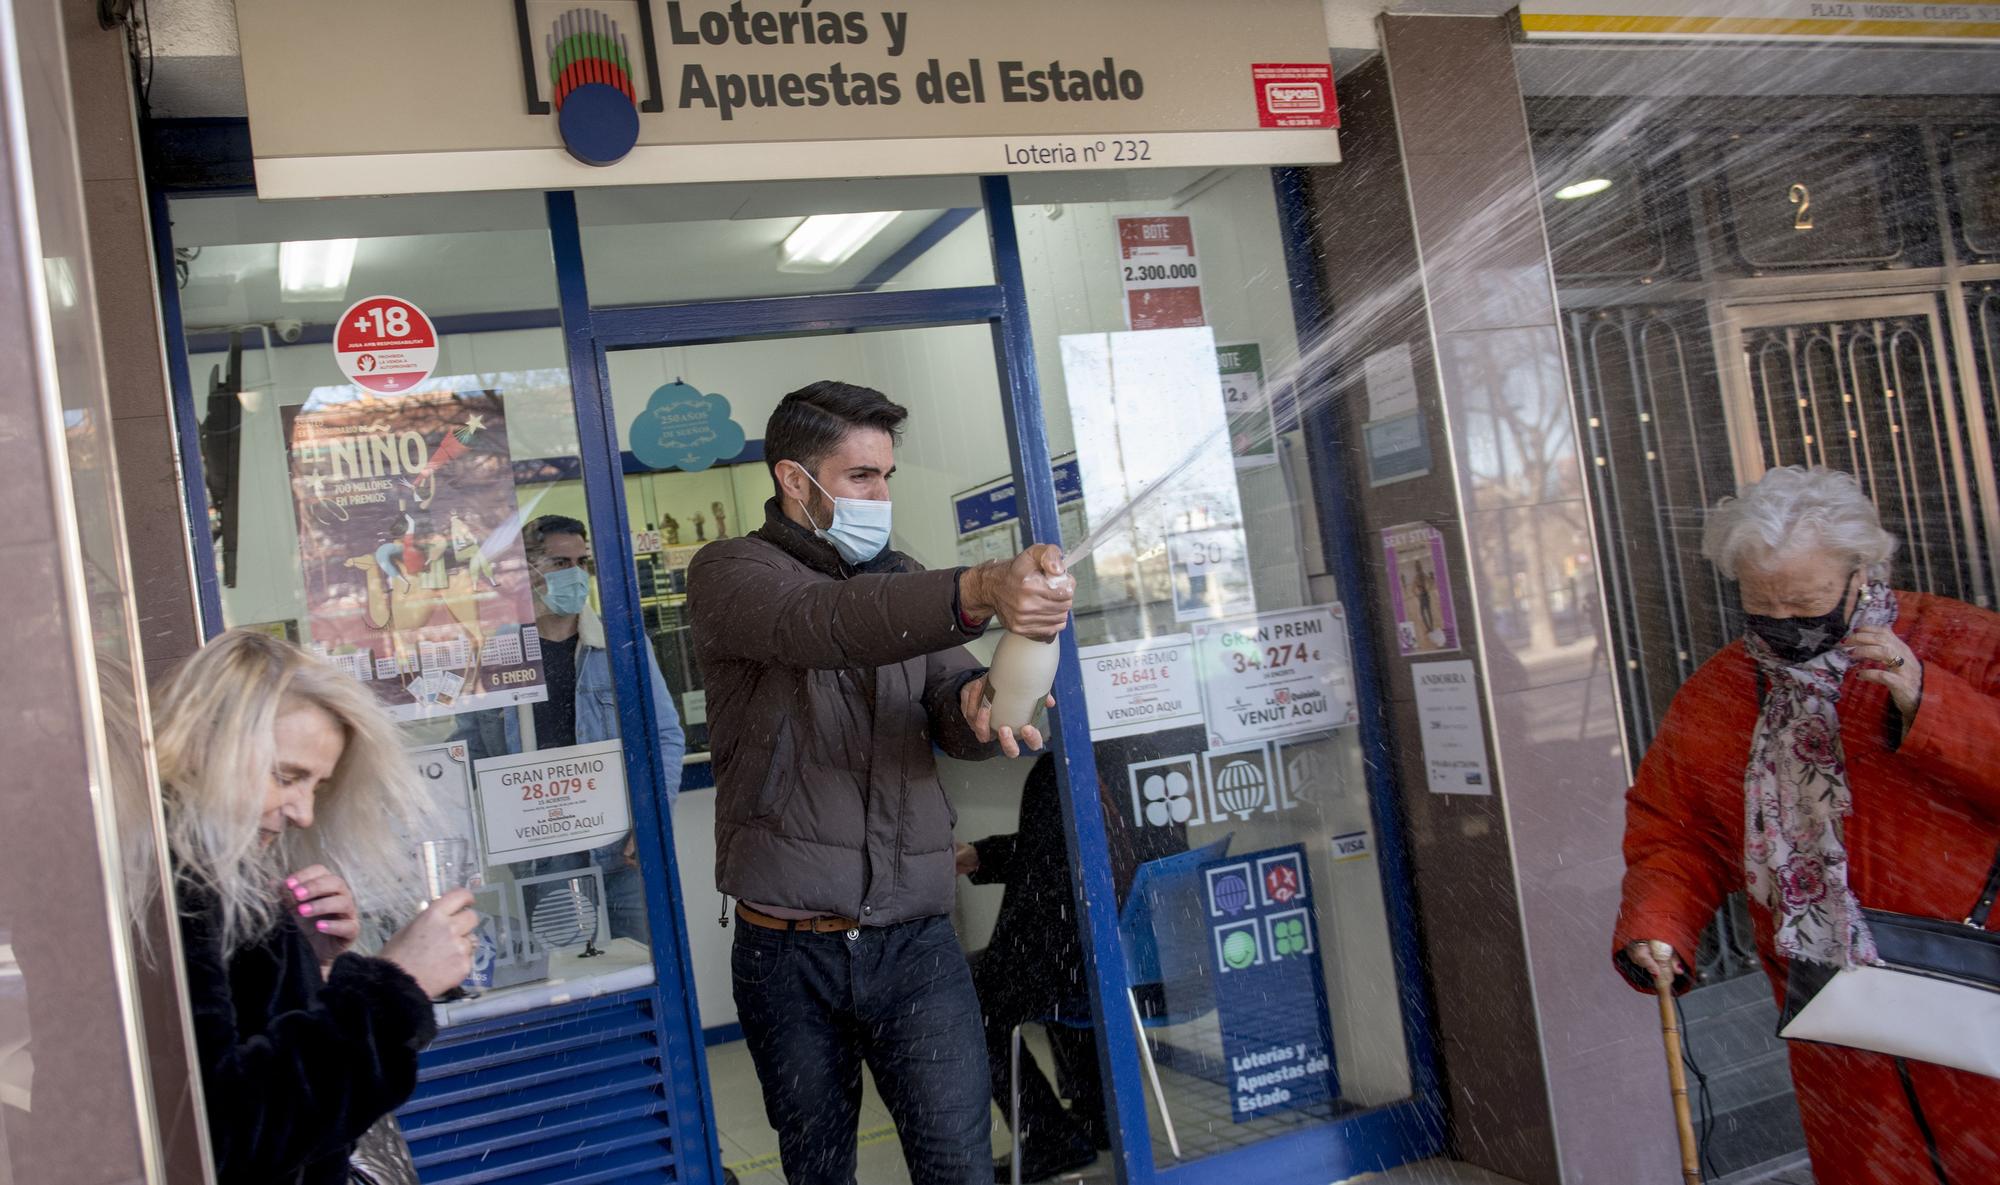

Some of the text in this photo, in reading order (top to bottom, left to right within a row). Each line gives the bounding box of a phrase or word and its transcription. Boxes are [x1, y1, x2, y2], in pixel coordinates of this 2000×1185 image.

[1811, 3, 1854, 17] PLAZA
[1864, 4, 1915, 18] MOSSEN
[667, 0, 908, 57] Loterías y
[678, 57, 1144, 121] Apuestas del Estado
[1004, 140, 1152, 165] Loteria nº 232
[1788, 184, 1813, 229] 2
[1142, 224, 1170, 239] BOTE
[1124, 264, 1197, 281] 2.300.000
[353, 306, 411, 338] +18
[1217, 352, 1241, 369] OTE
[301, 423, 428, 481] EL NIÑO
[353, 480, 393, 493] MILLONES
[336, 492, 386, 507] EN PREMIOS
[1221, 619, 1322, 647] GRAN PREMI
[1097, 649, 1178, 672] GRAN PREMIO
[1232, 642, 1321, 674] 34.274 €
[492, 668, 537, 686] 6 ENERO
[1111, 665, 1169, 687] 26.641 €
[1106, 703, 1154, 720] VENDIDO
[1238, 706, 1286, 726] VENUT
[1291, 696, 1328, 718] AQUÍ
[501, 760, 604, 787] GRAN PREMIO
[521, 777, 597, 801] 28.079 €
[515, 821, 571, 839] VENDIDO
[574, 812, 605, 831] AQUÍ
[1336, 839, 1366, 854] VISA
[1232, 1043, 1306, 1073] Loterías y
[1236, 1054, 1330, 1093] Apuestas del
[1238, 1086, 1291, 1112] Estado
